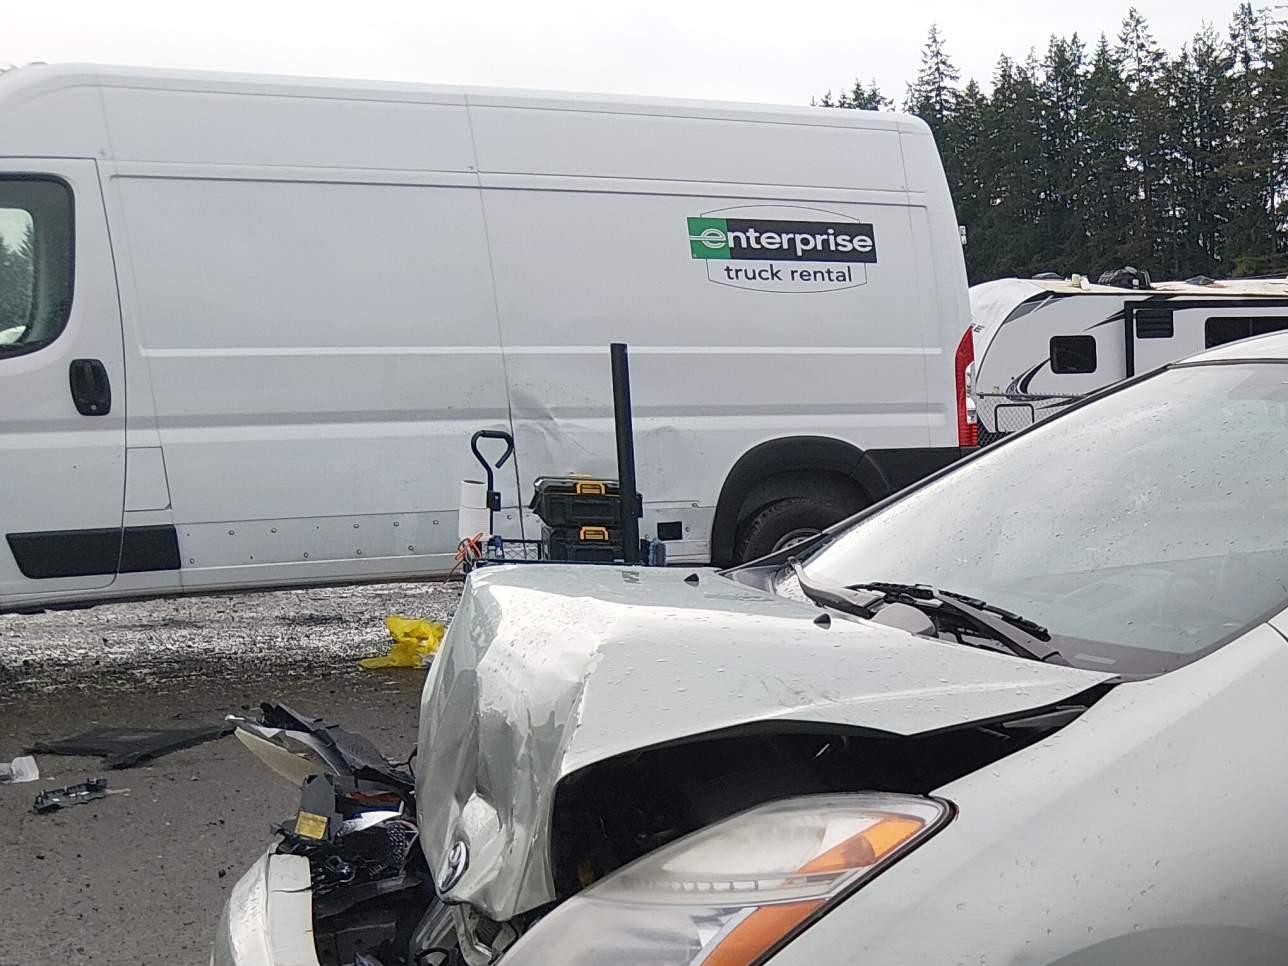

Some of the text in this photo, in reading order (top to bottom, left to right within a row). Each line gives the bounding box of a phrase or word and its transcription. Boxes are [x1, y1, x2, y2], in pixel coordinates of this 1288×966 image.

[689, 227, 874, 257] enterprise
[723, 263, 853, 283] truck rental
